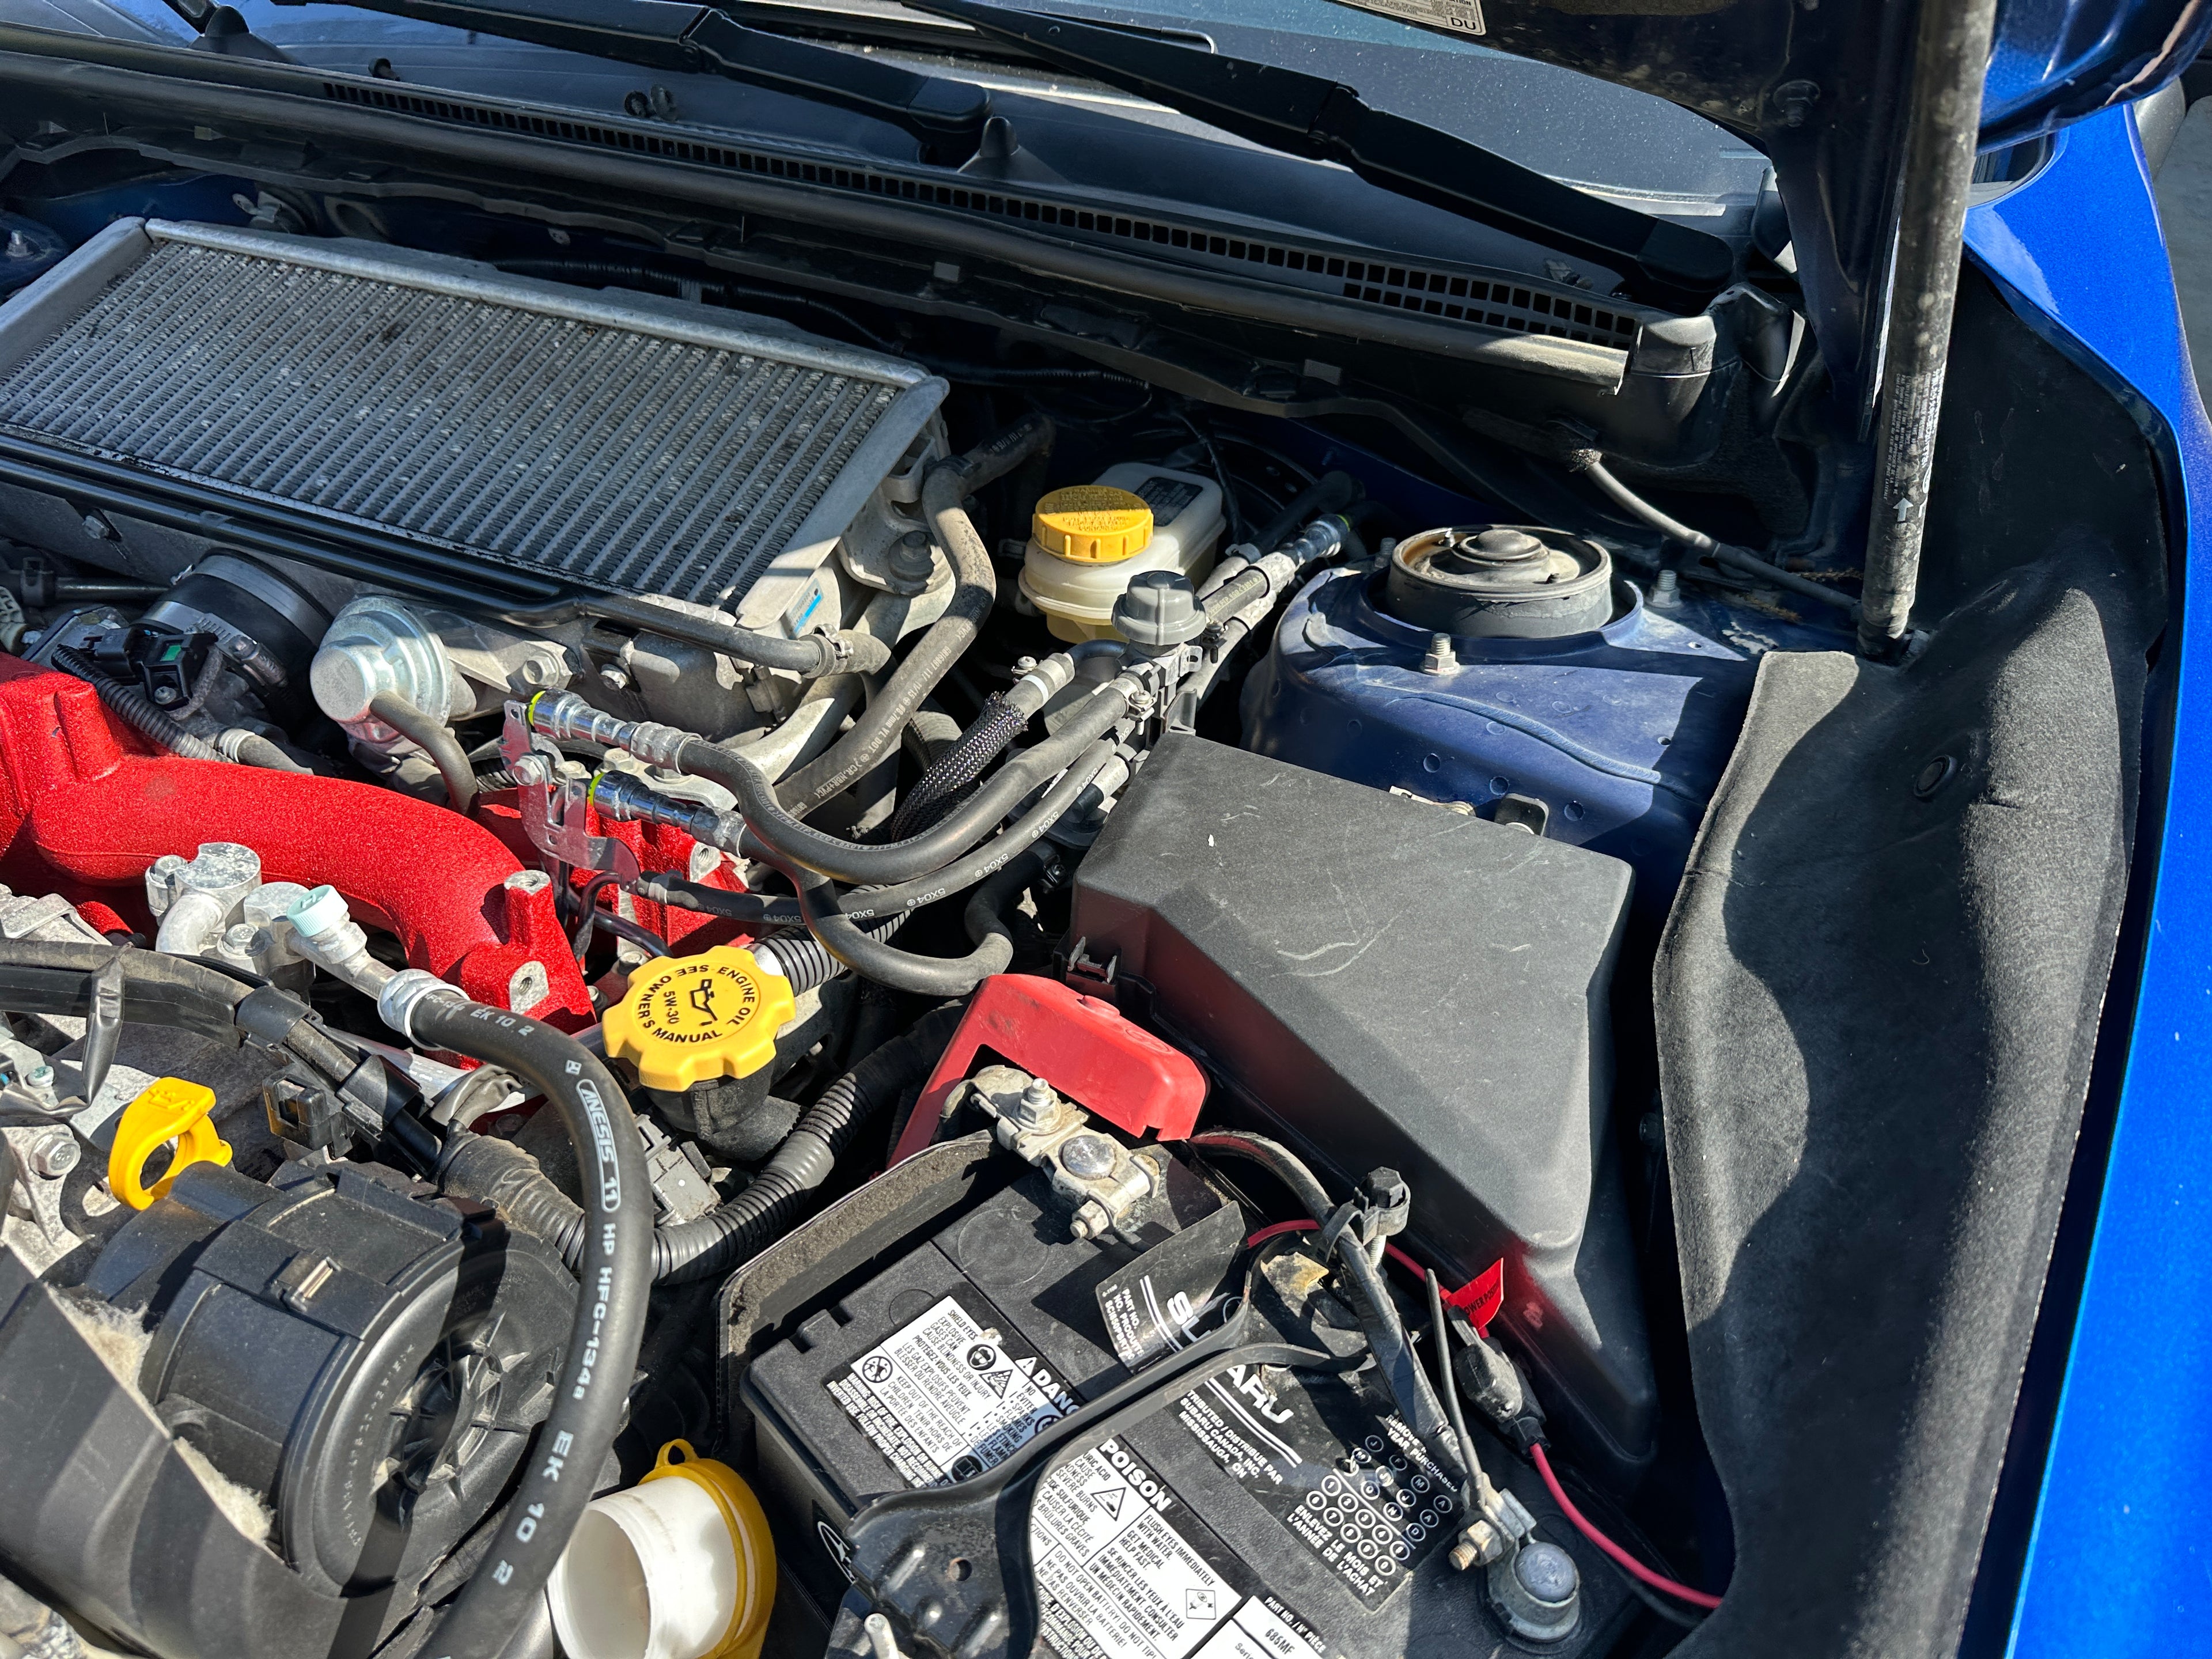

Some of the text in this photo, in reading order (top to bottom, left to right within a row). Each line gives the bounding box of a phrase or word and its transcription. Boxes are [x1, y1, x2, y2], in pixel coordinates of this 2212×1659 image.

[1450, 17, 1477, 31] DU
[868, 736, 880, 753] DOT
[637, 964, 723, 1044] SEE OWNER'S MANUAL
[663, 990, 680, 1025] 5W-30
[716, 967, 756, 1026] ENGINE OIL
[495, 1015, 535, 1036] 10 2
[600, 1222, 617, 1256] HP
[946, 1308, 980, 1343] SHIELD EYES.
[1122, 1287, 1140, 1330] PART NO.
[571, 1266, 613, 1401] HFC-134a
[929, 1321, 959, 1351] GASES CAN
[937, 1315, 967, 1346] EXPLOSIVE
[901, 1341, 971, 1415] LES GAZ EXPLOSIFS PEUVENT
[911, 1332, 974, 1400] PROTÉGEZ-VOUS LES YEUX.
[921, 1327, 992, 1400] CAUSE BLINDNESS OR INJURY
[838, 1378, 872, 1413] DISASSEMBLE
[893, 1347, 966, 1425] BLESSER OU RENDRE AVEUGLE
[1015, 1390, 1040, 1415] ÉVITER
[1024, 1385, 1036, 1397] NO
[825, 1379, 917, 1481] INVERTED FOLLOW PROPER CHARGING
[865, 1395, 923, 1456] RISK EXPLOSION
[878, 1387, 940, 1453] LA PORTÉE DES ENFANTS
[887, 1380, 953, 1452] CHILDREN TENIR HORS DE
[895, 1374, 963, 1448] KEEP OUT OF THE REACH OF
[986, 1422, 1001, 1436] LES
[994, 1414, 1024, 1444] SMOKING
[1003, 1408, 1028, 1433] FLAMES
[1010, 1402, 1035, 1427] SPARKS
[1178, 1396, 1247, 1463] SUBARU CANADA,
[1384, 1412, 1422, 1448] REMOVE
[541, 1429, 575, 1483] EK
[969, 1434, 999, 1466] DE FUMER
[977, 1428, 993, 1443] LES
[1176, 1410, 1248, 1479] MISSISSAUGA, ON
[1385, 1426, 1411, 1451] YEAR
[1055, 1468, 1080, 1493] SEVERE
[1073, 1457, 1096, 1480] CAUSE
[1094, 1464, 1112, 1482] ACID
[1098, 1436, 1172, 1513] POISON
[1263, 1464, 1283, 1486] PAR
[514, 1501, 546, 1544] 10
[1036, 1501, 1071, 1536] BRÛLURES
[1040, 1490, 1095, 1545] CAUSER LA CÉCITÉ
[1054, 1487, 1091, 1525] SULFURIQUE
[1118, 1535, 1153, 1571] HELP FAST.
[1126, 1528, 1166, 1570] GET MEDICAL
[1135, 1520, 1175, 1561] WITH WATER.
[1143, 1513, 1215, 1588] FLUSH EYES IMMEDIATELY
[1286, 1511, 1376, 1596] L'ANNÉE DE L'ACHAT
[1294, 1504, 1384, 1588] ENLEVEZ LE MOIS ET
[491, 1559, 515, 1586] 2
[1106, 1546, 1185, 1630] SE RINCER LES YEUX L'EAU
[1044, 1575, 1094, 1627] PAS RENVERSER
[1044, 1558, 1129, 1649] NE PAS OUVRIR LA BATTERIE!
[1053, 1550, 1067, 1563] DO
[1062, 1559, 1080, 1577] NOT
[1075, 1573, 1095, 1593] OPEN
[1089, 1589, 1123, 1624] BATTERY!
[1118, 1620, 1132, 1634] DO
[1127, 1630, 1145, 1648] NOT
[1088, 1562, 1162, 1642] UN MÉDECIN RAPIDEMENT.
[1096, 1552, 1180, 1642] IMMÉDIATEMENT. CONSULTER
[1049, 1601, 1096, 1650] D'EXPLOSION OU
[1263, 1594, 1285, 1616] PART
[1279, 1608, 1297, 1626] NO.
[1302, 1628, 1329, 1654] PIÈCE
[1263, 1626, 1296, 1657] 685MF
[1070, 1639, 1092, 1659] POUR
